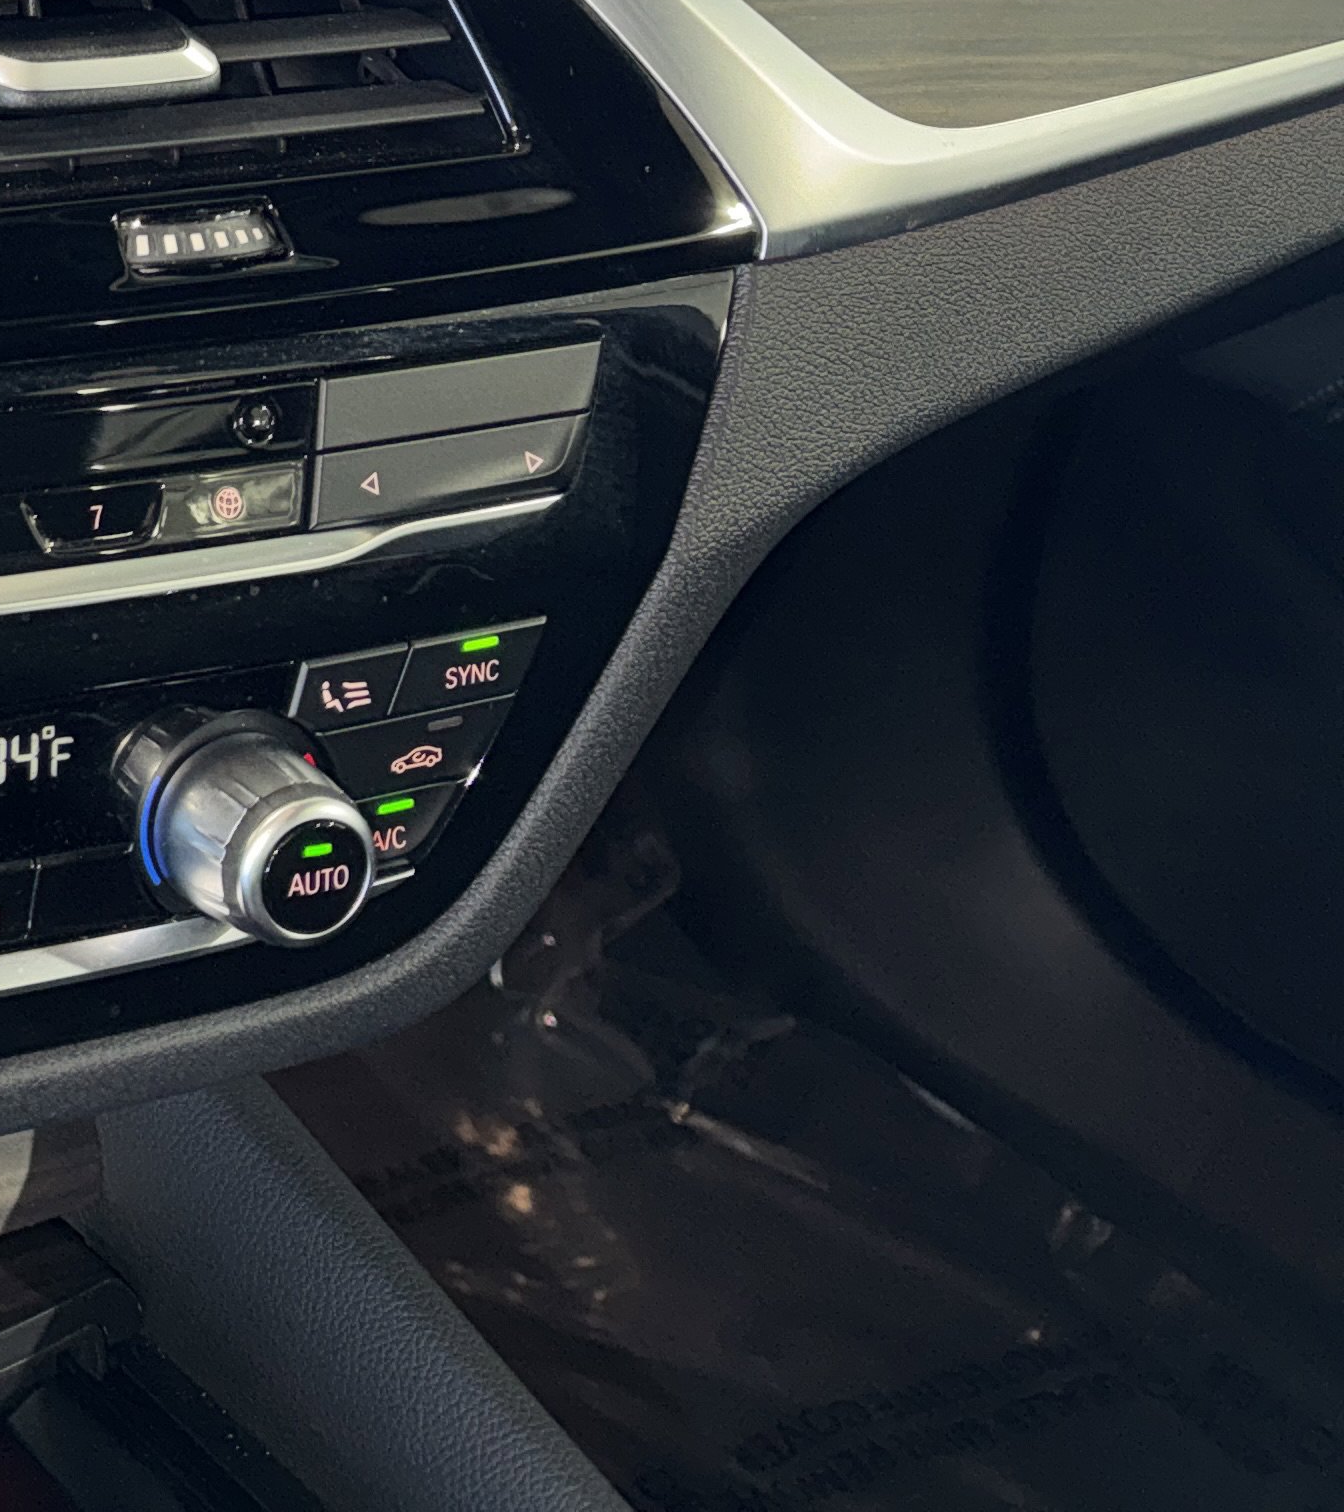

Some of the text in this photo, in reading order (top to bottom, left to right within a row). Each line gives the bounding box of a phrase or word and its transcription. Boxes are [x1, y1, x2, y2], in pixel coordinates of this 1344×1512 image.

[89, 504, 104, 532] 7
[444, 659, 501, 691] SYNC
[287, 864, 350, 899] AUTO
